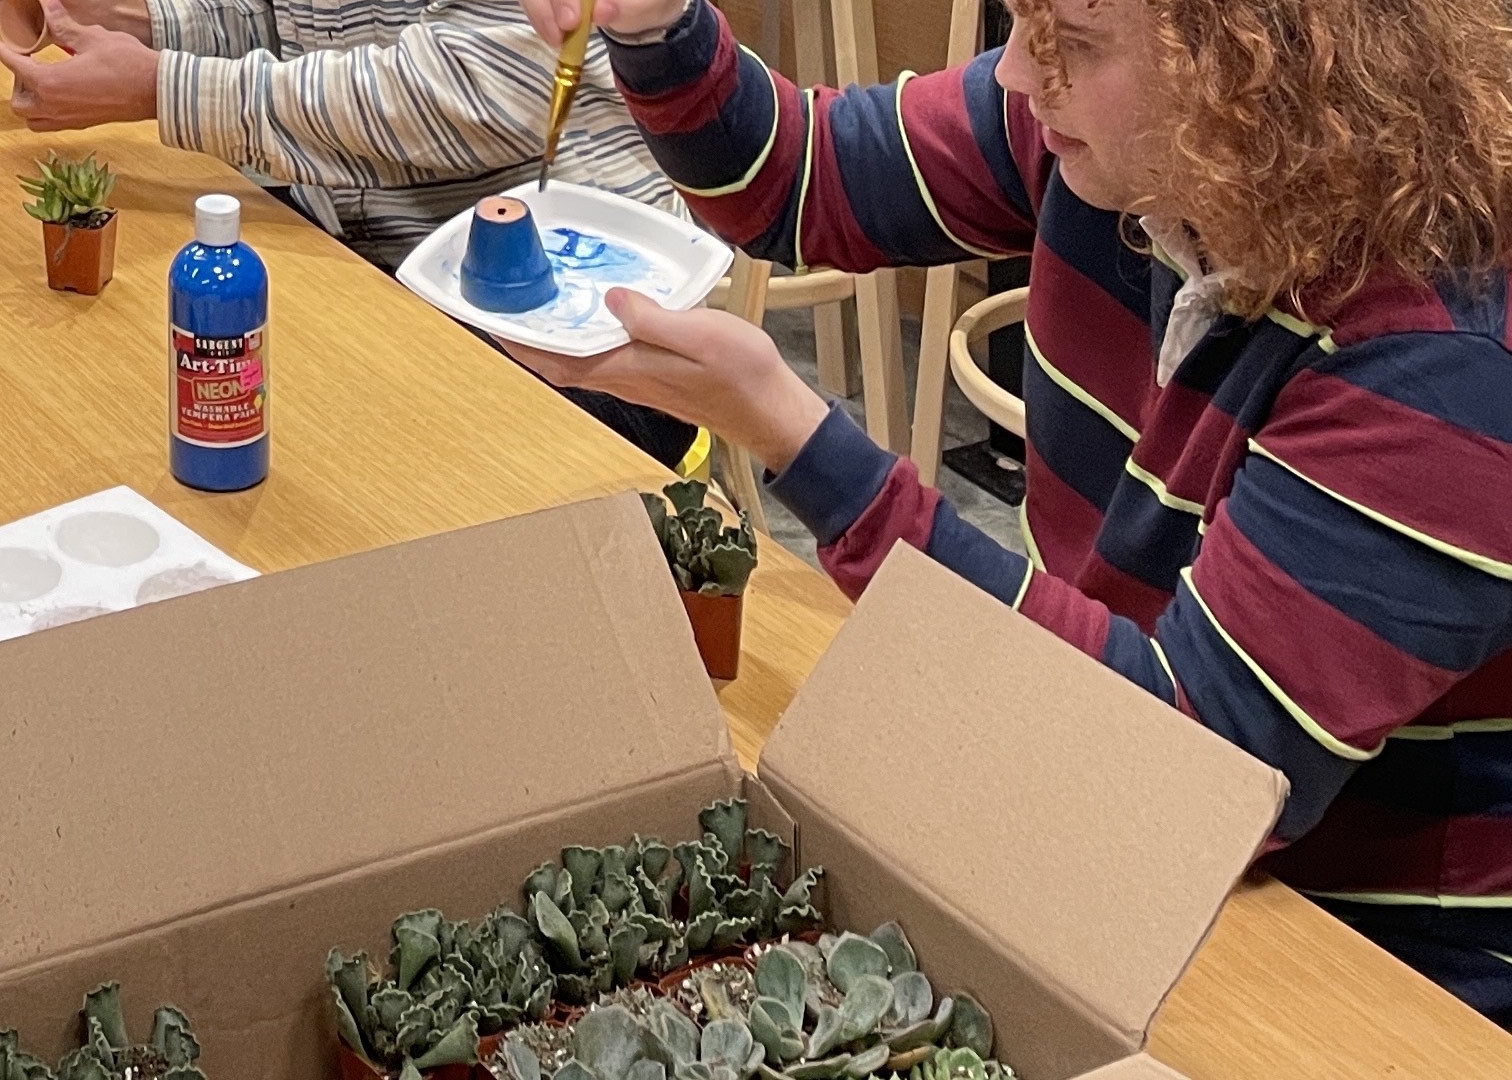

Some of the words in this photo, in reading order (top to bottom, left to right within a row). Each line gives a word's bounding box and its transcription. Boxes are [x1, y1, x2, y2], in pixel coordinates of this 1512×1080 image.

[195, 338, 243, 349] SARGENT
[196, 381, 242, 400] NEON
[181, 407, 230, 421] TEMPERA
[194, 403, 249, 413] WASHABLE
